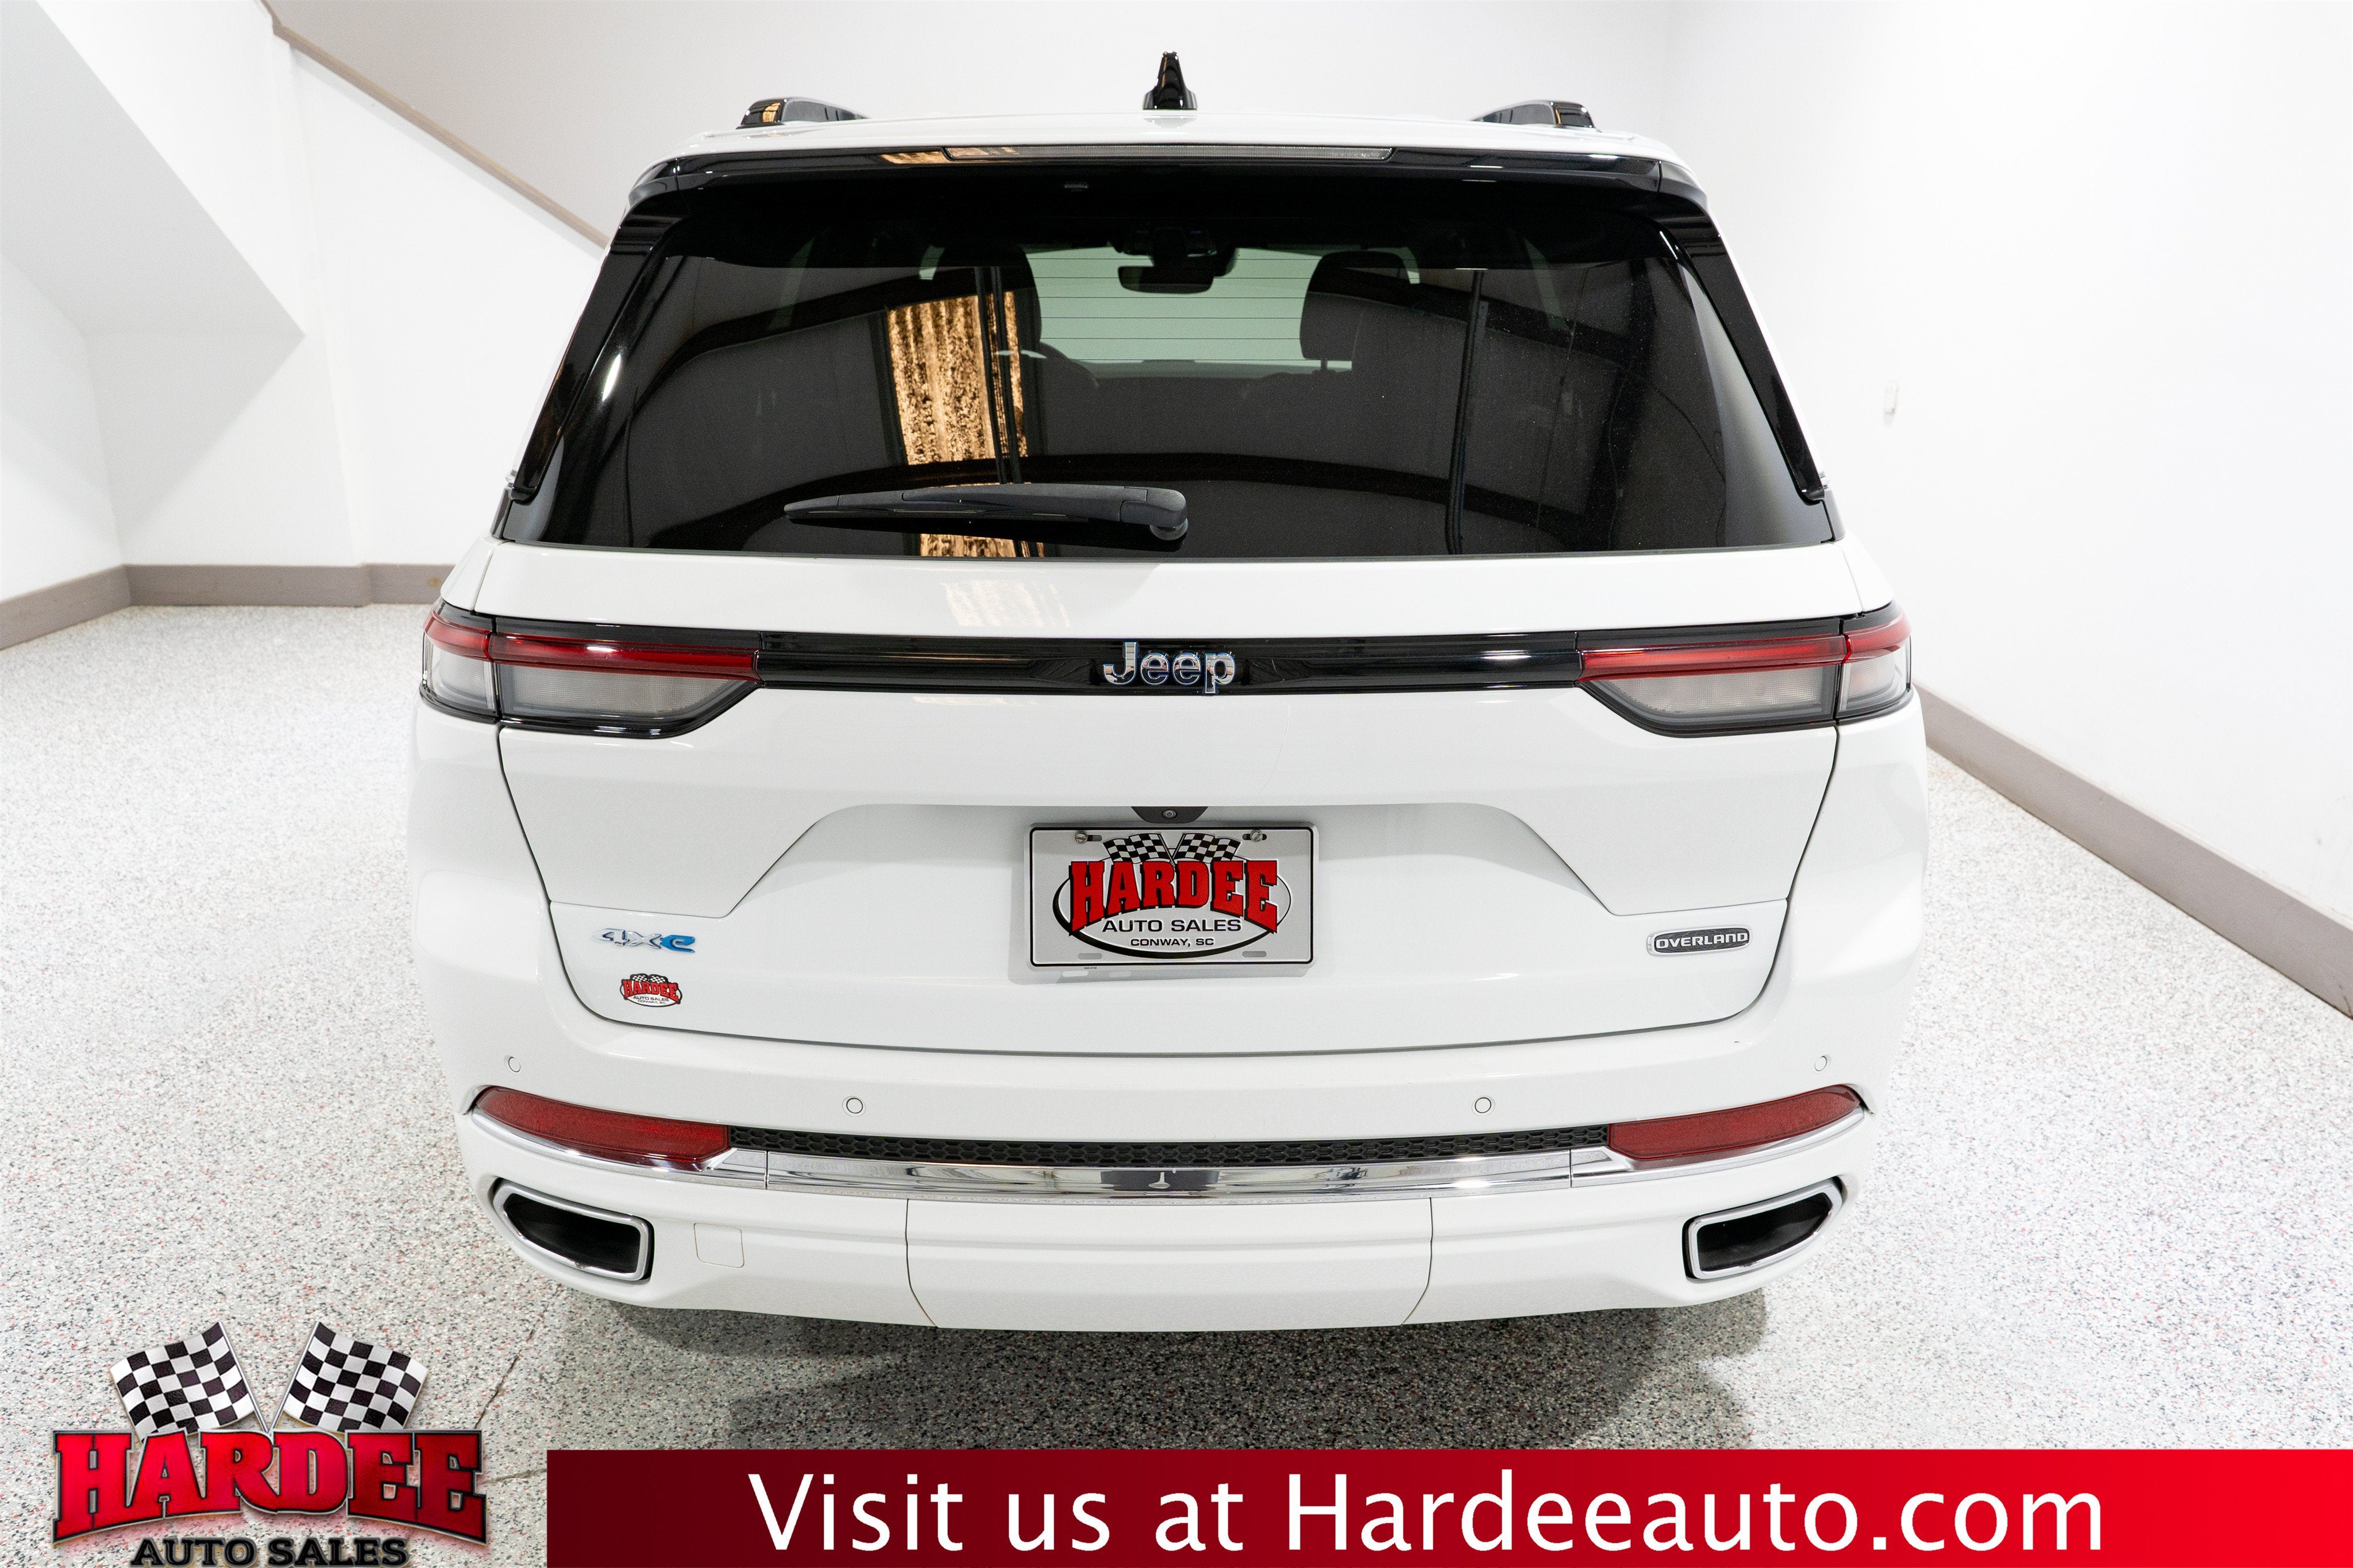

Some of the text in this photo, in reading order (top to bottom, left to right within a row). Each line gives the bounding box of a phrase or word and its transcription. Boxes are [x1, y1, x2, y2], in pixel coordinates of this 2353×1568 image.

[1103, 642, 1236, 694] Jeep
[1070, 860, 1278, 936] HARDEE
[1102, 919, 1241, 932] AUTO SALES
[1131, 938, 1214, 947] CONWAY, SC
[1656, 932, 1749, 949] OVERLAND
[623, 980, 680, 1003] HARDEE
